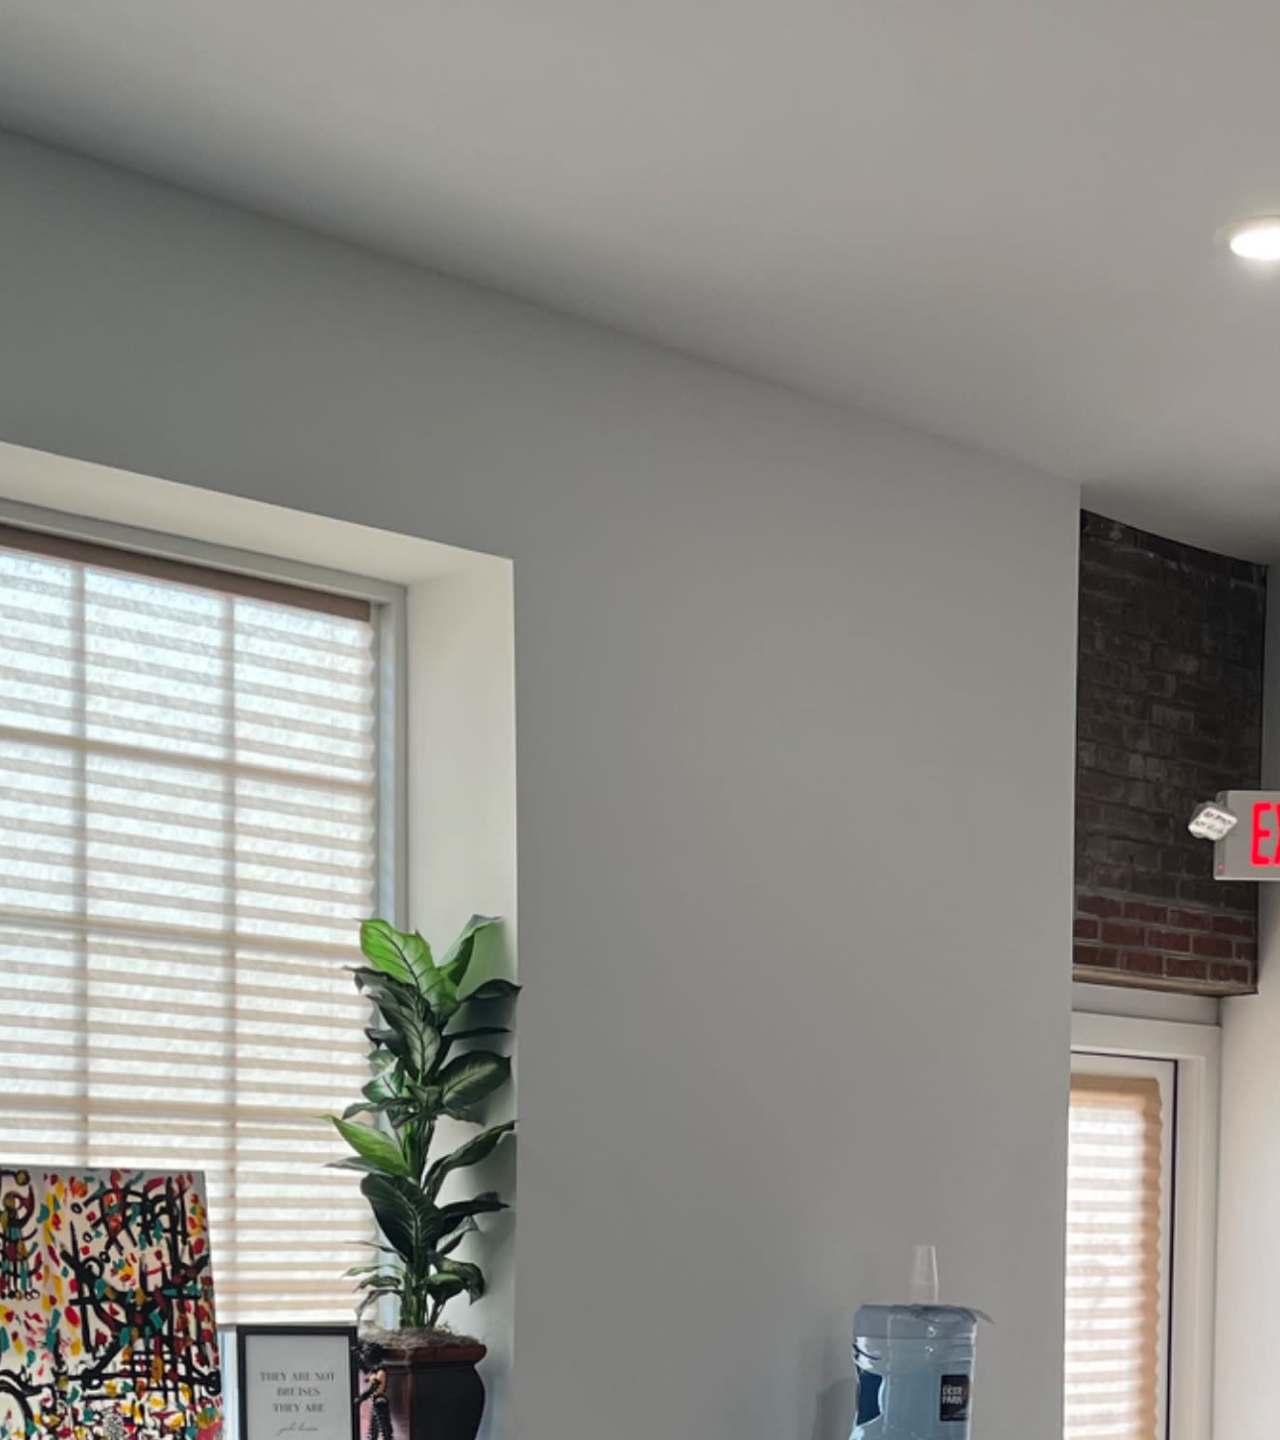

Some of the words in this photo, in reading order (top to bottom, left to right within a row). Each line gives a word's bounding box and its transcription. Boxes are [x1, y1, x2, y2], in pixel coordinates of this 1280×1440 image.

[259, 1371, 287, 1381] THEY
[292, 1371, 310, 1381] ARE
[314, 1371, 335, 1381] NOT
[273, 1402, 300, 1413] THEY
[305, 1402, 324, 1413] ARE
